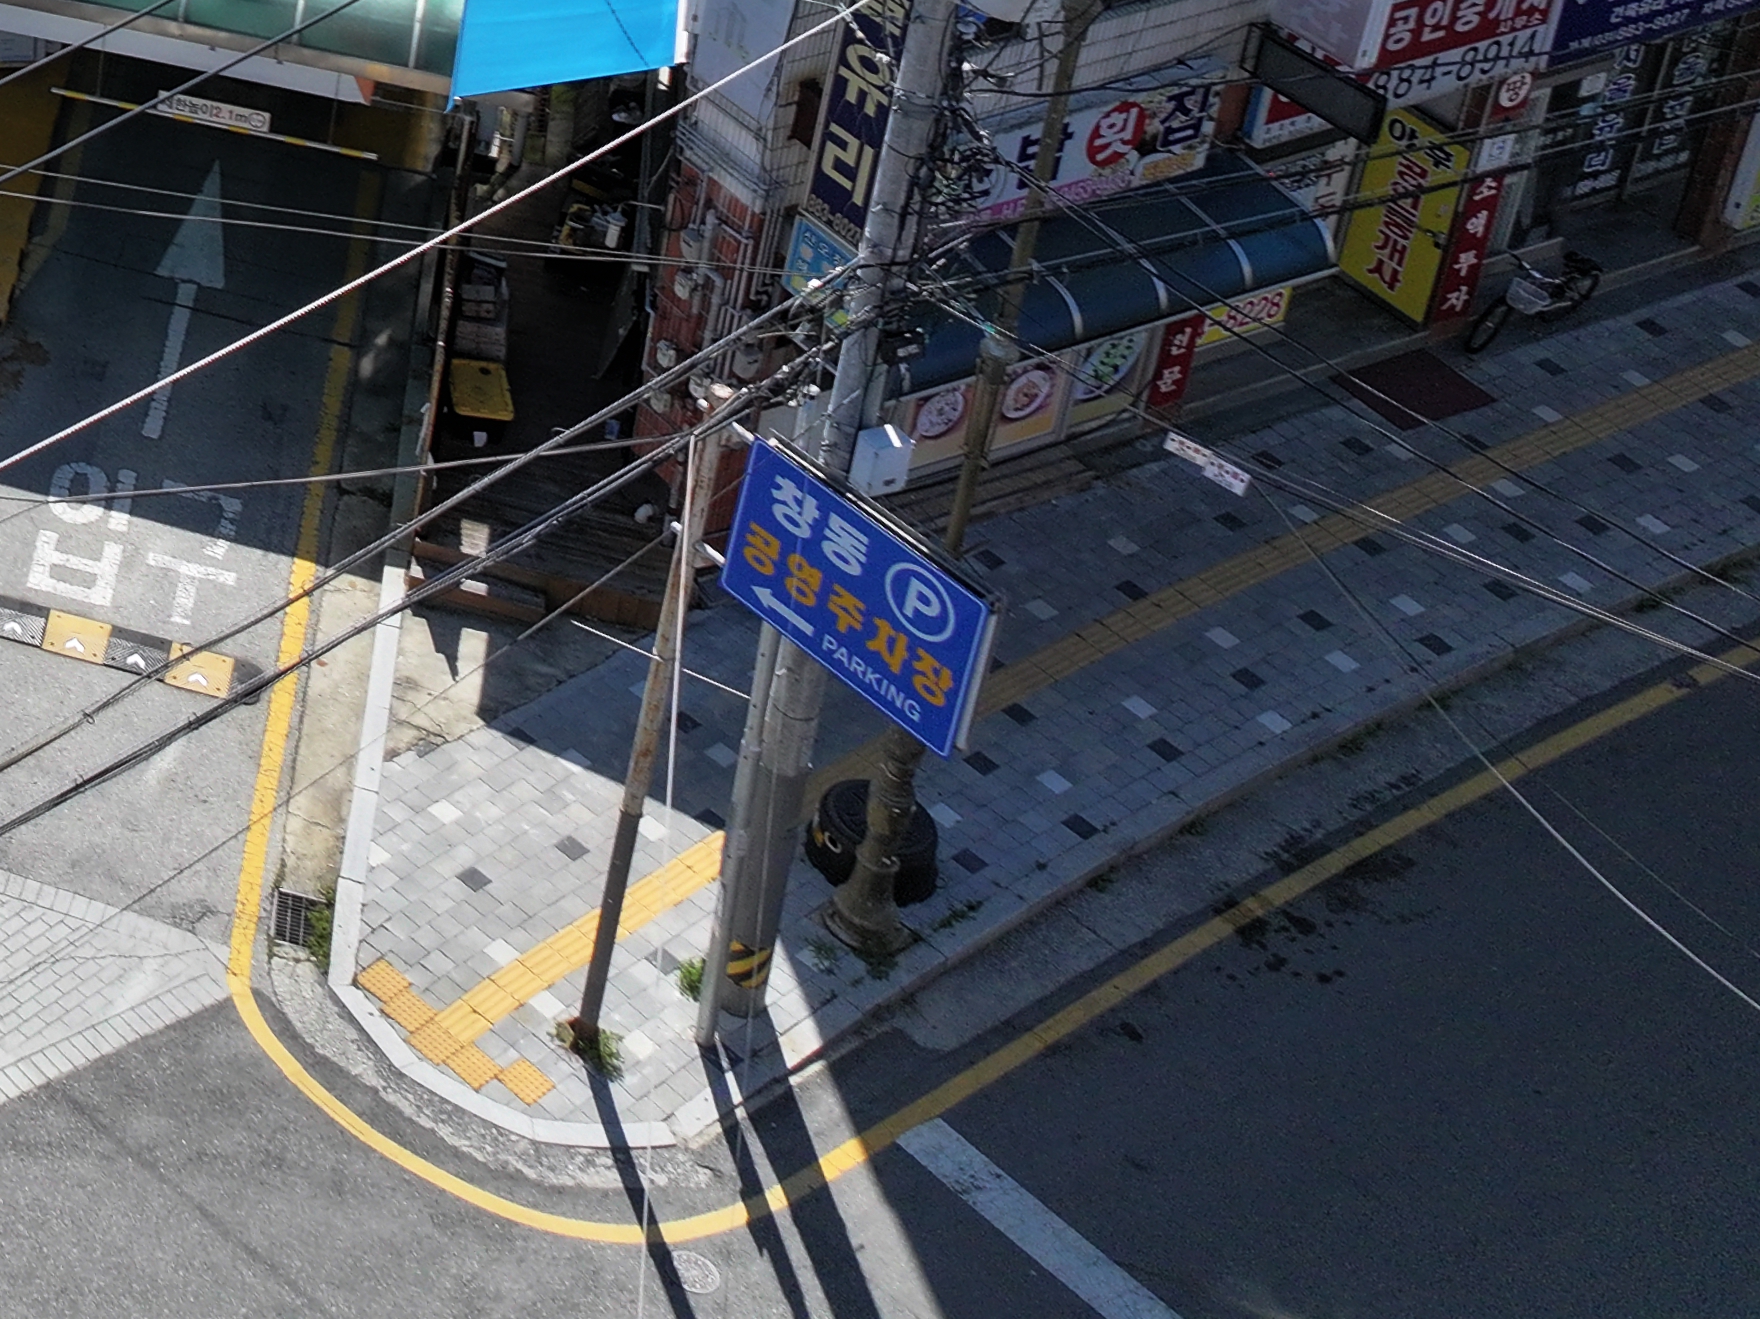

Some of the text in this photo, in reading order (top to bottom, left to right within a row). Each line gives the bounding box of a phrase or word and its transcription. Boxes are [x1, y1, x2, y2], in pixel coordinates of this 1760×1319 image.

[1372, 30, 1540, 100] 884-8914
[1440, 176, 1500, 313] 소액투자
[26, 462, 244, 626] 입구
[770, 474, 871, 570] 창동
[742, 519, 957, 709] 공영주차장
[820, 633, 924, 726] PARKING
